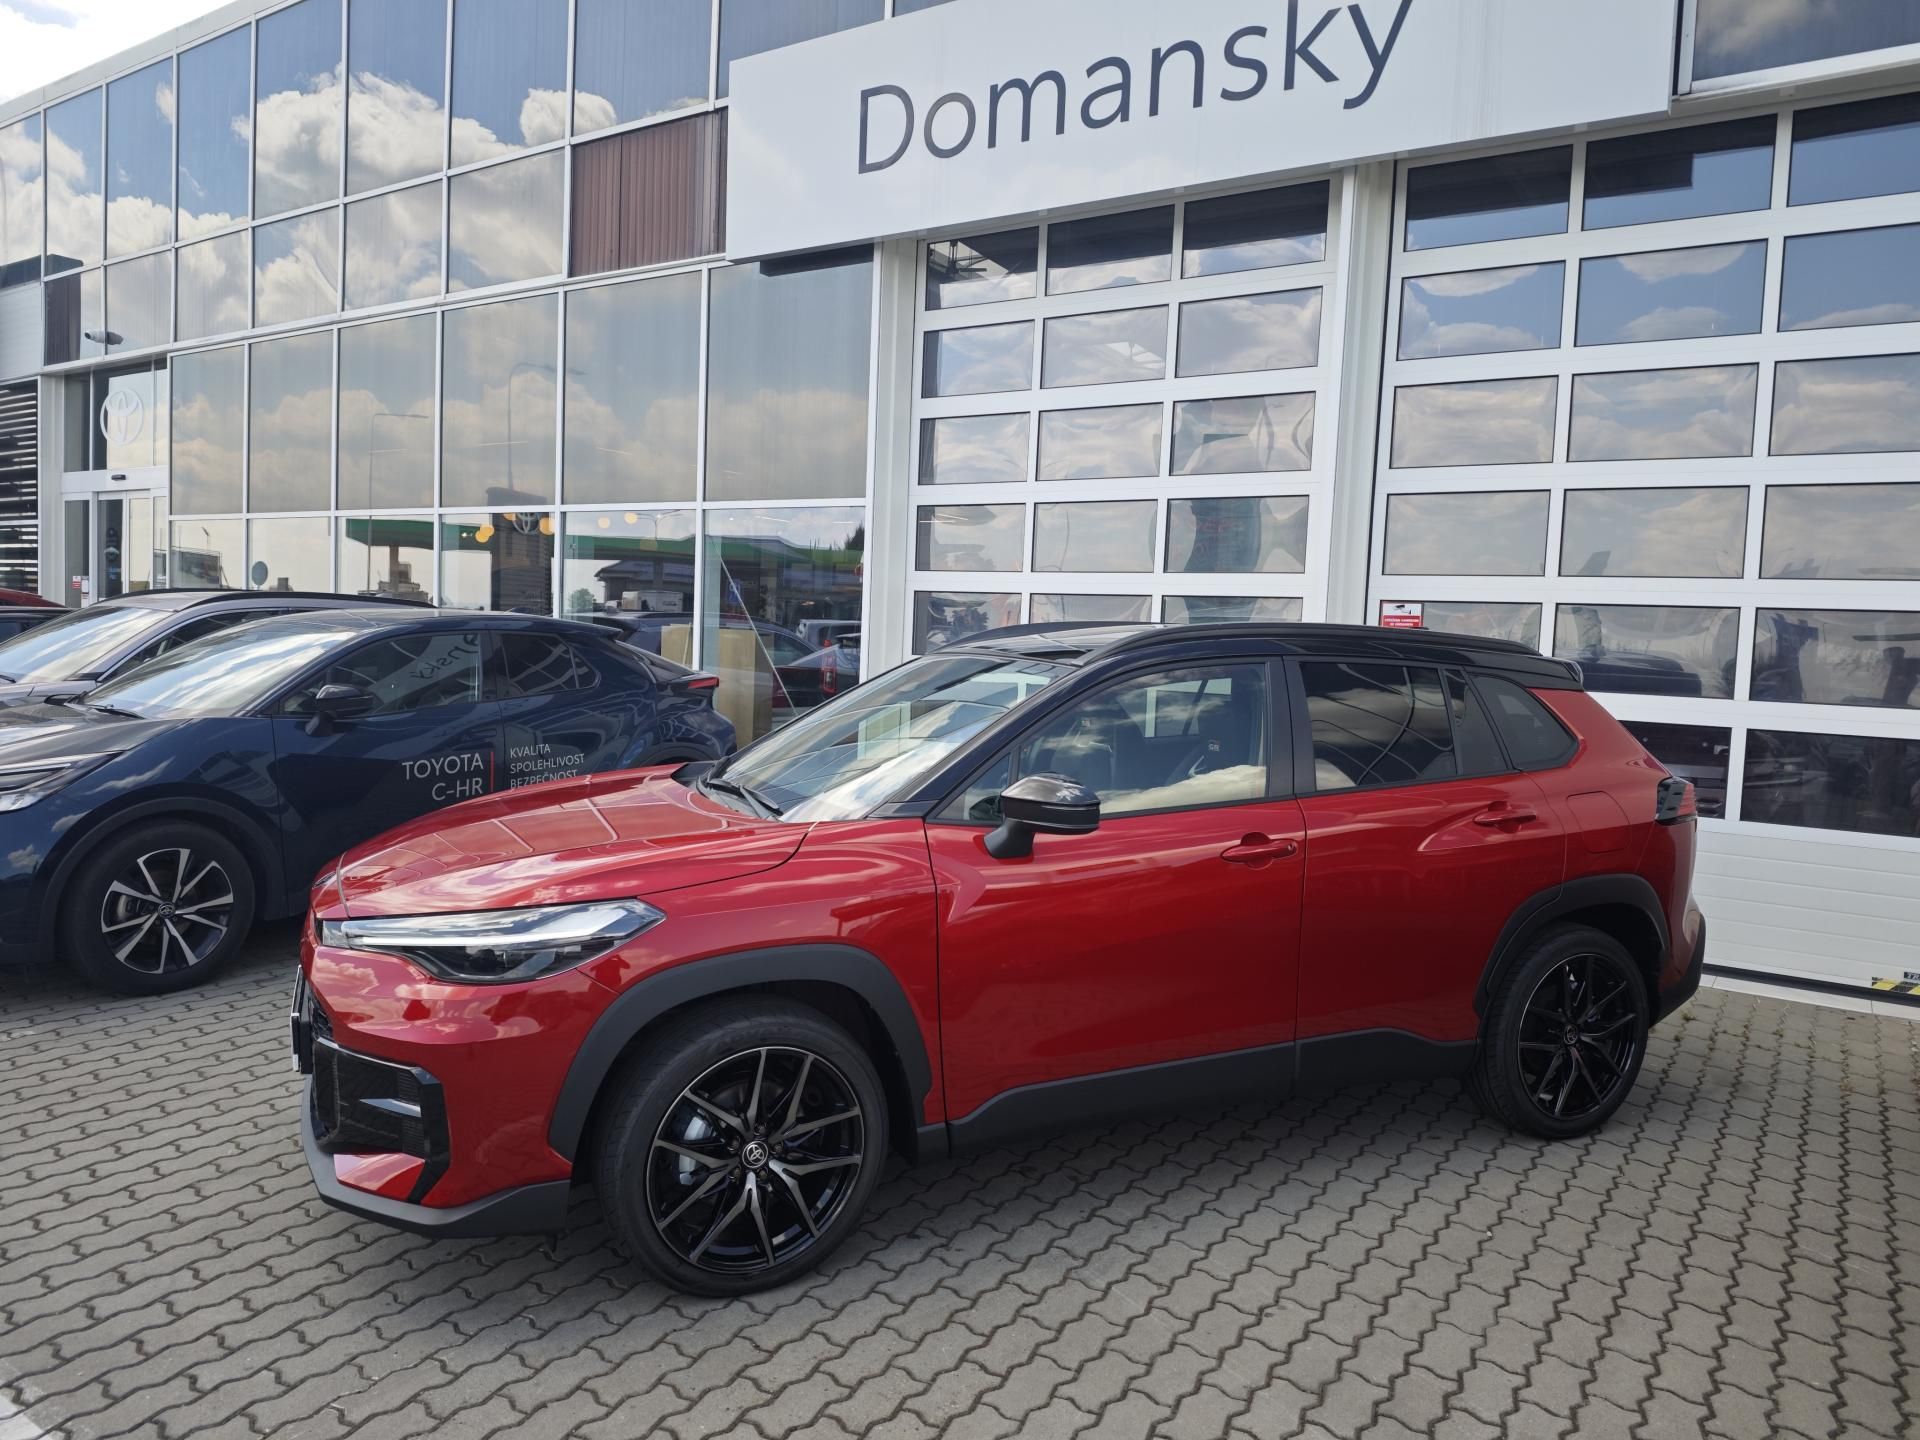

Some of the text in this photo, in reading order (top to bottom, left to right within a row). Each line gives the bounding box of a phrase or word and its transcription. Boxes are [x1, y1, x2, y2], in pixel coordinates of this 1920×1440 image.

[857, 0, 1413, 175] Domansky
[509, 743, 551, 759] KVALITA
[401, 752, 484, 780] TOYOTA
[509, 753, 585, 774] SPOLEHLIVOST
[431, 777, 484, 801] C-HR
